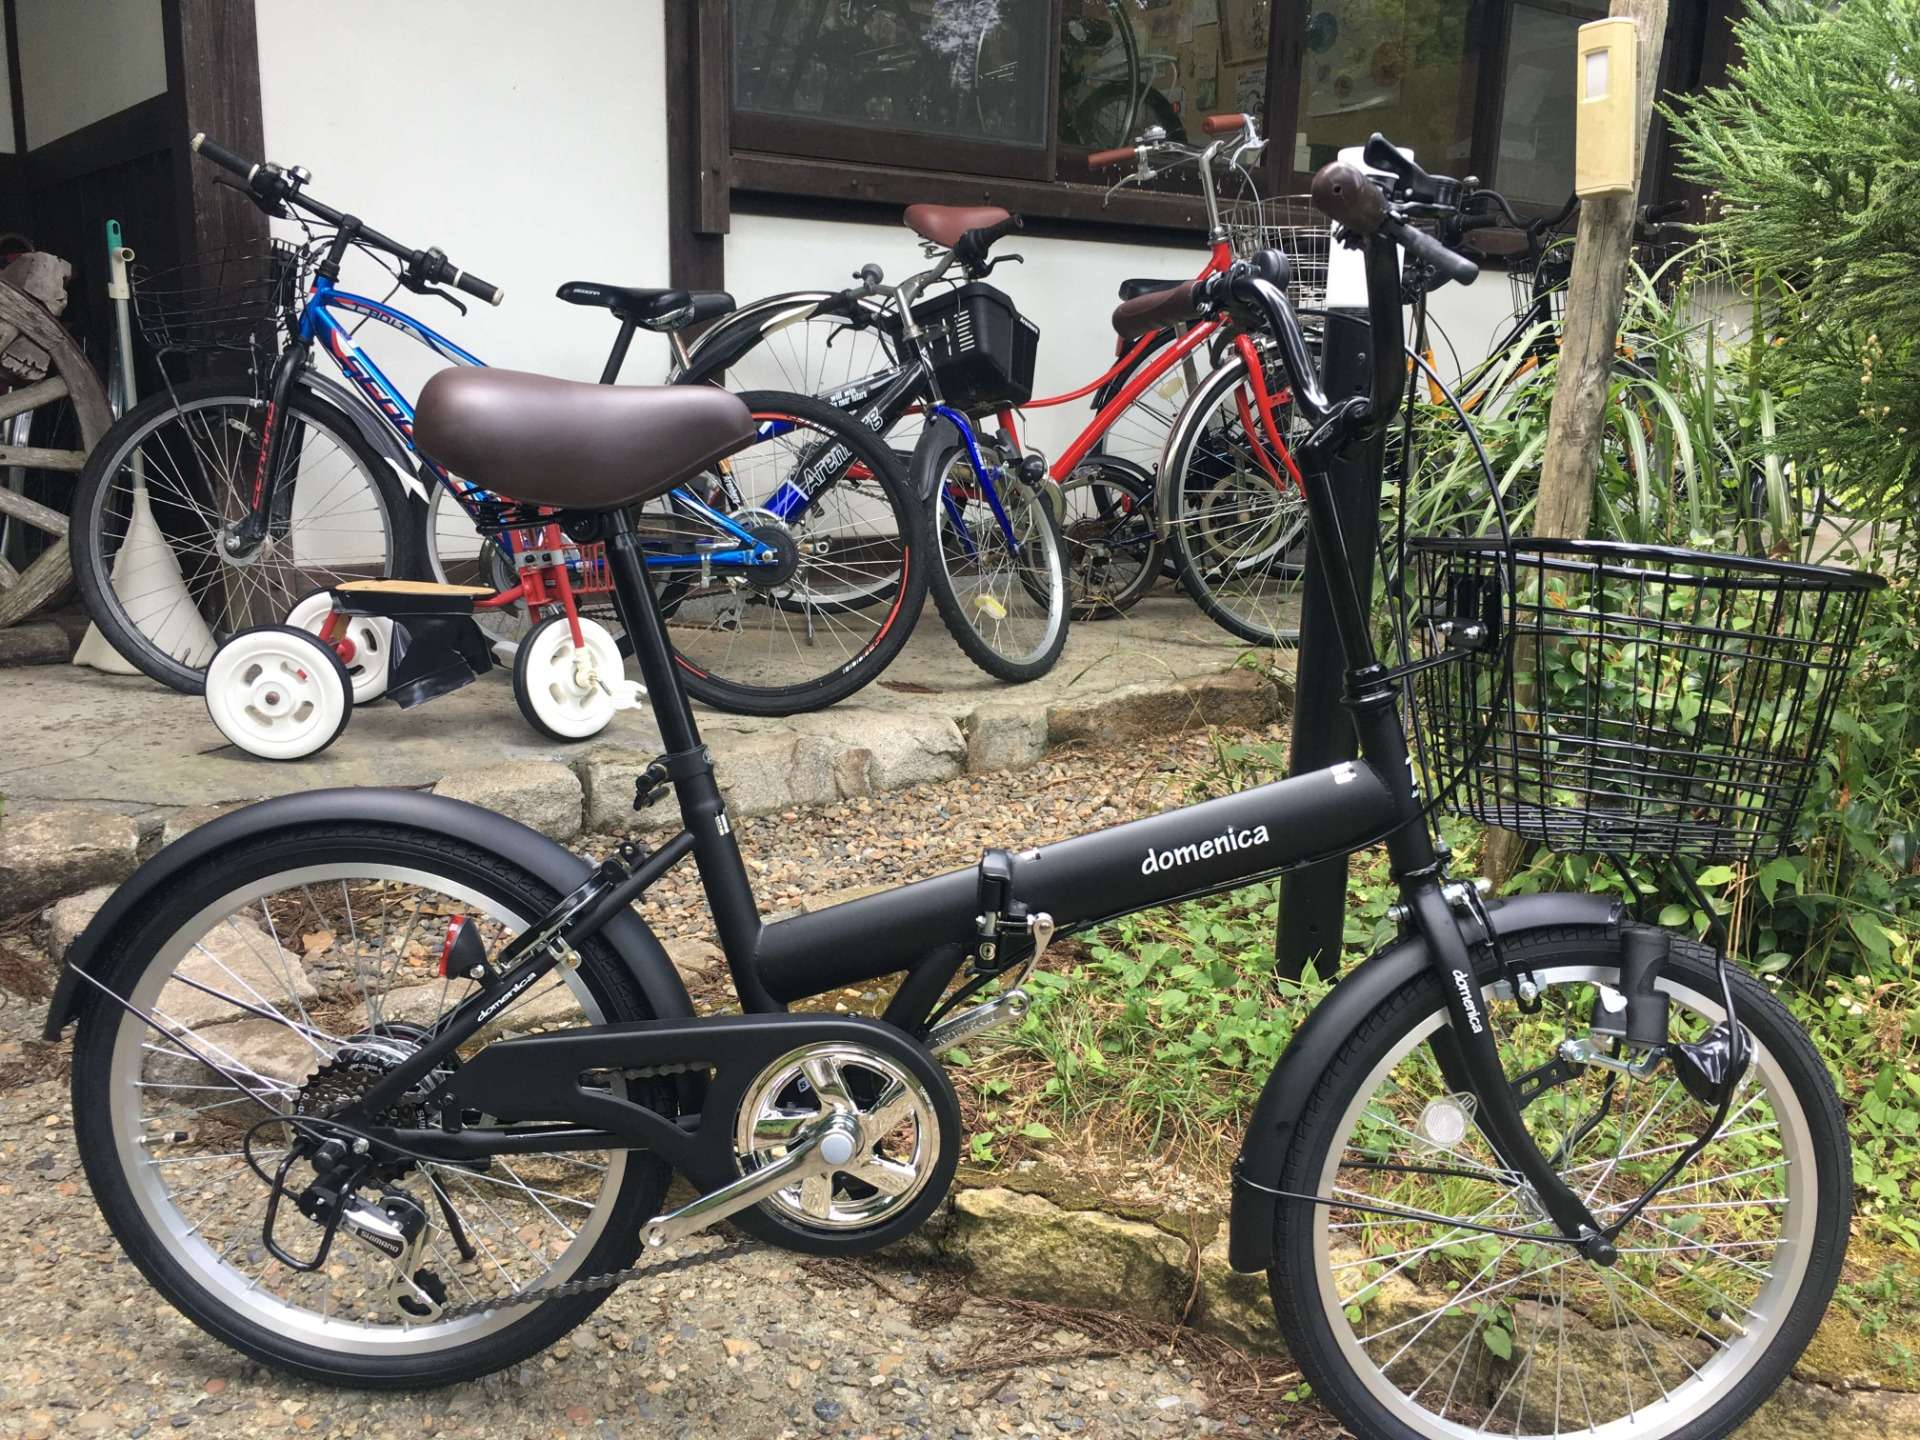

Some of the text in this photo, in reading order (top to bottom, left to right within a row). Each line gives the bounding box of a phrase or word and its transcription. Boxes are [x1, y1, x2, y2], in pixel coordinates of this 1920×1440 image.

[830, 390, 843, 402] will
[1141, 824, 1270, 876] domenica
[477, 972, 537, 1022] domenica
[1452, 969, 1483, 1034] domenica
[360, 1230, 399, 1253] SHIMANO
